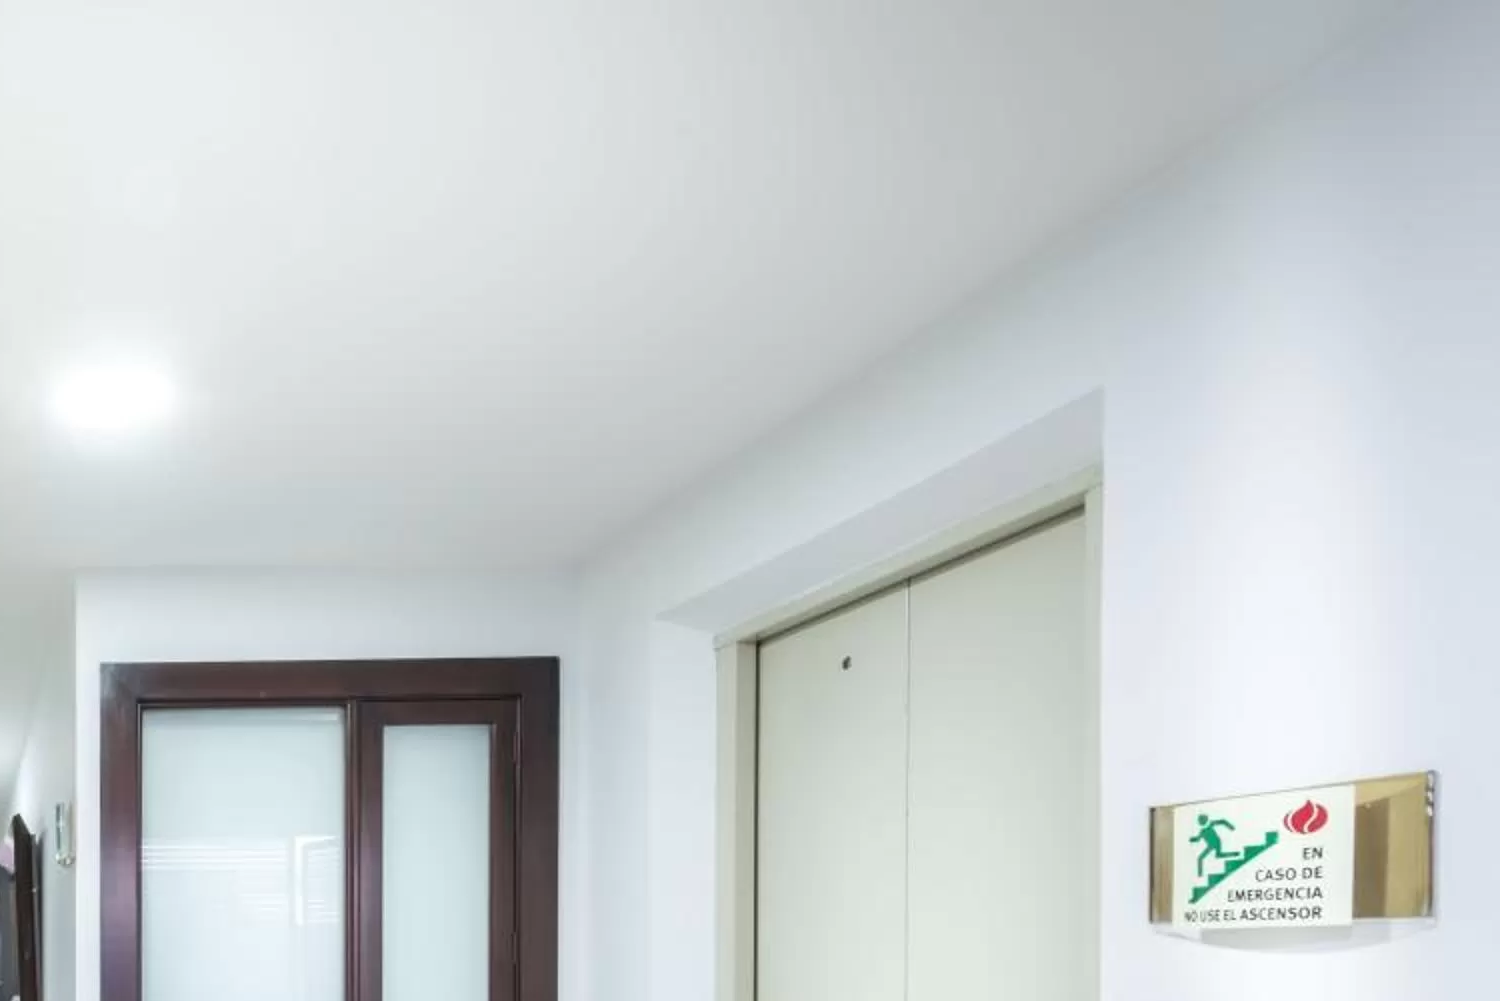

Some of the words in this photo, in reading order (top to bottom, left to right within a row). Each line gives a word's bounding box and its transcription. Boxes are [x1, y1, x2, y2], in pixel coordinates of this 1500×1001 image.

[1302, 847, 1323, 860] EN
[1255, 867, 1297, 882] CASO
[1301, 866, 1323, 879] DE
[1227, 886, 1323, 902] EMERGENCIA
[1184, 909, 1198, 922] NO
[1200, 909, 1220, 921] USE
[1223, 908, 1236, 920] EL
[1239, 905, 1323, 921] ASCENSOR
